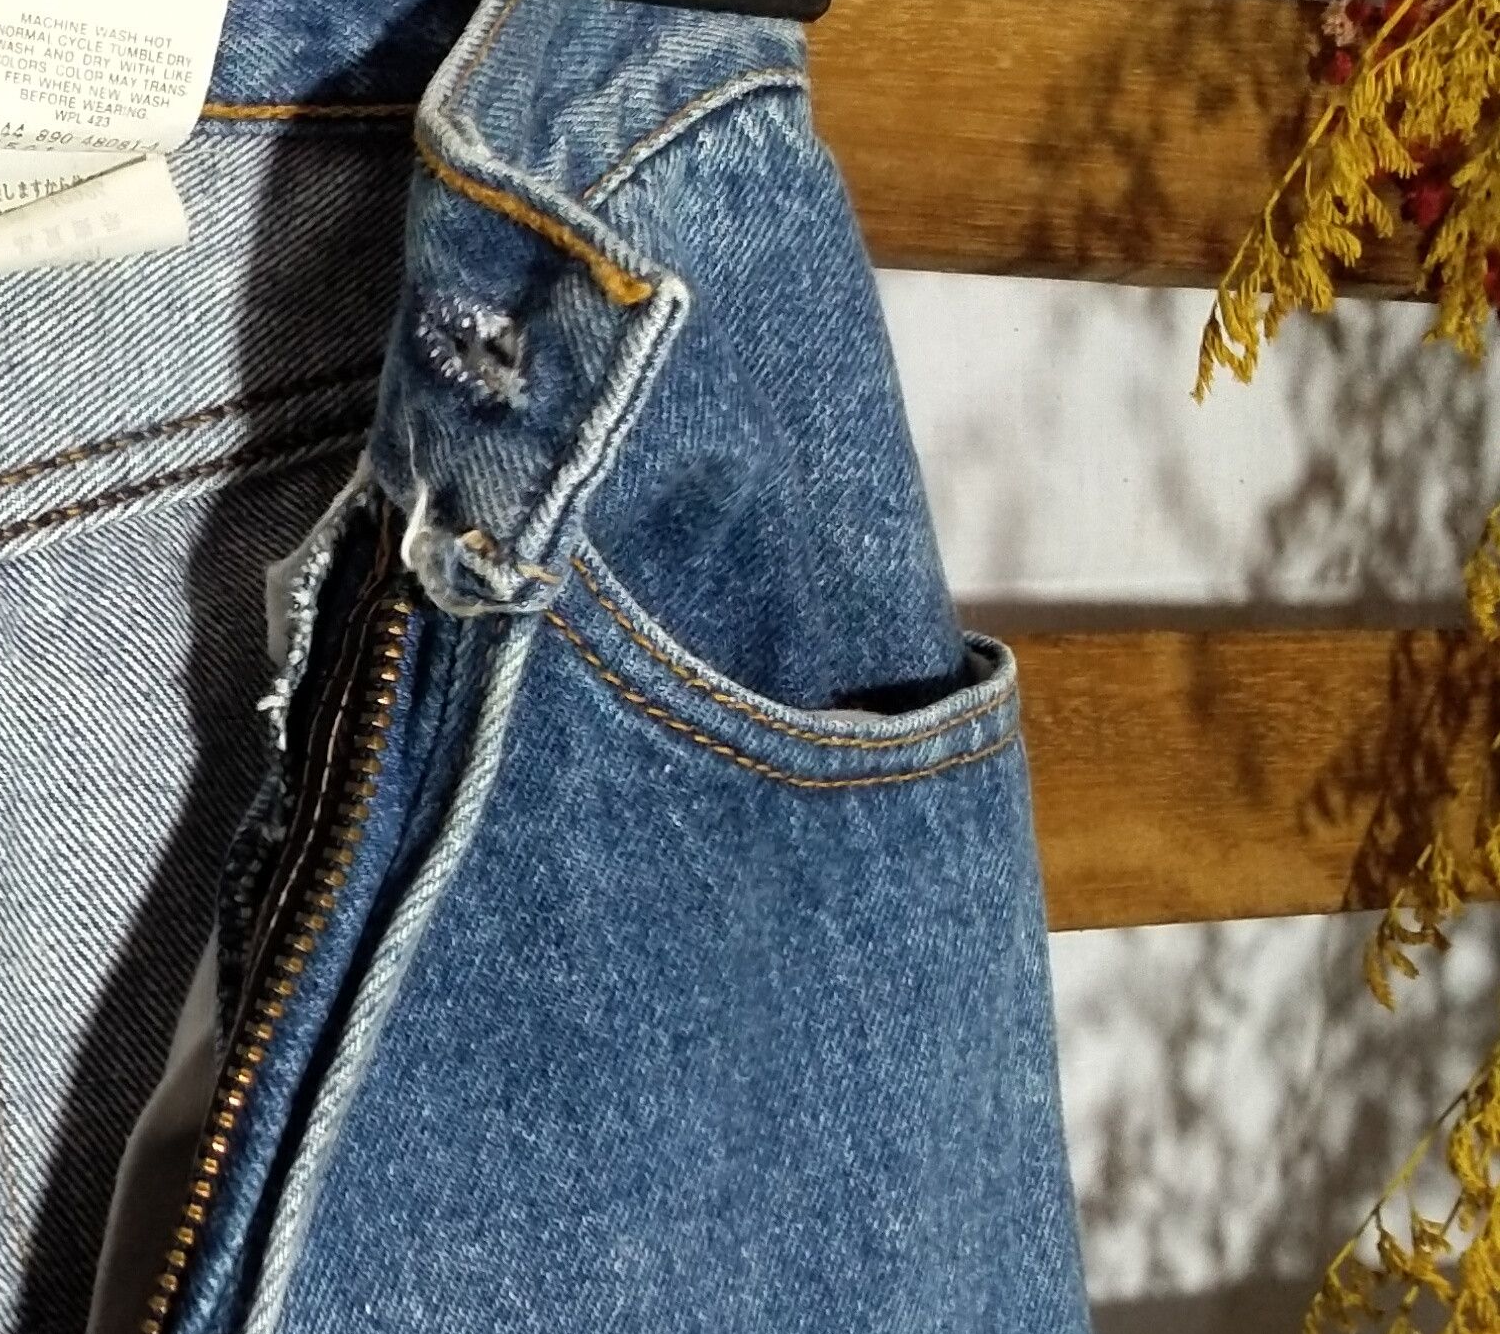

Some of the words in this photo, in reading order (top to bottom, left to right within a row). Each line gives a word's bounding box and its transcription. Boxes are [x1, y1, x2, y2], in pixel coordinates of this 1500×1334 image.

[20, 12, 88, 36] MACHINE
[95, 26, 138, 44] WASH
[144, 35, 172, 49] HOT
[58, 34, 103, 53] CYCLE
[111, 42, 164, 64] TUMBLE
[167, 53, 192, 68] DRY
[43, 48, 74, 63] AND
[82, 53, 111, 69] DRY
[120, 58, 155, 76] WITH
[163, 68, 193, 83] LIKE
[4, 70, 32, 84] FER
[39, 76, 82, 94] WHEN
[130, 92, 170, 108] WASH
[108, 72, 138, 87] MAY
[19, 88, 76, 109] BEFORE
[55, 109, 81, 125] WPL
[87, 115, 112, 128] 423
[35, 128, 74, 144] 890
